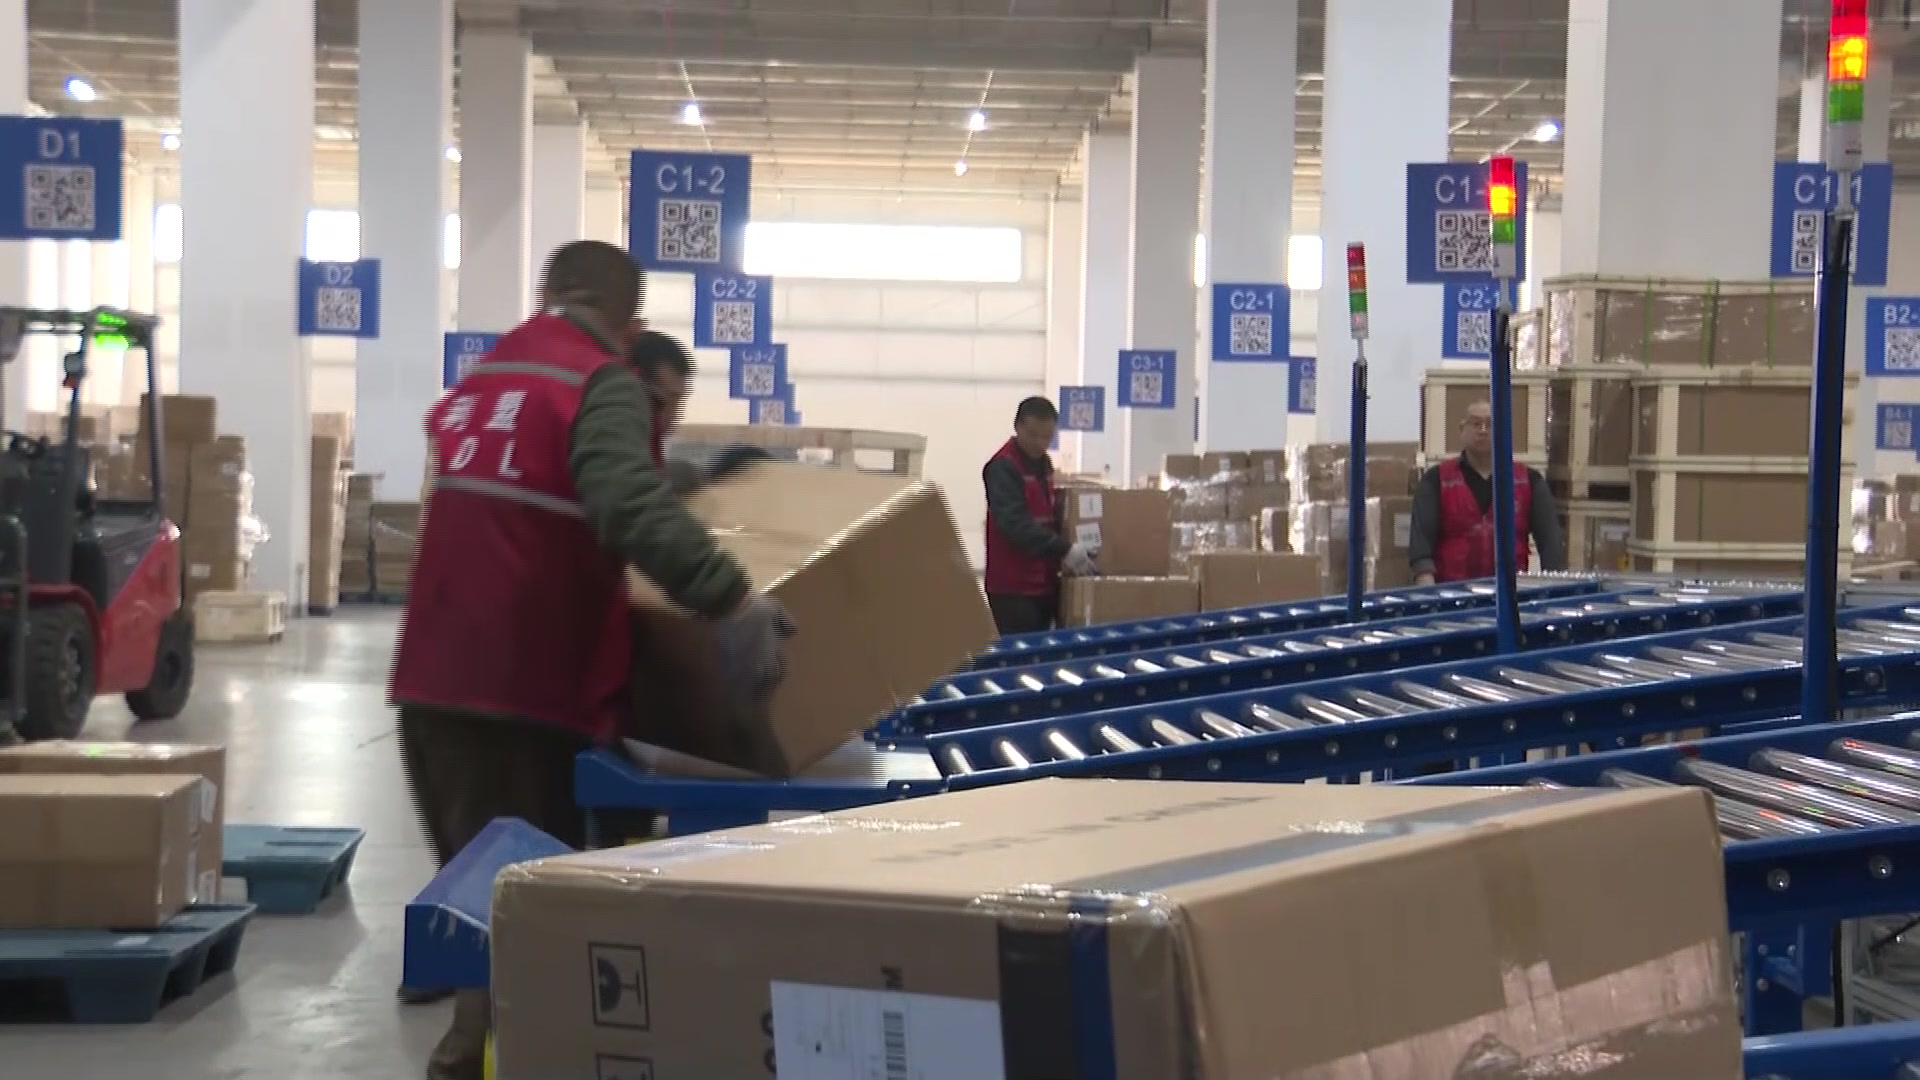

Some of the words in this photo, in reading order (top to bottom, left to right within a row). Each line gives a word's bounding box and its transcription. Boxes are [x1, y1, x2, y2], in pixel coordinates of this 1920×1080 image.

[39, 128, 81, 159] D1
[656, 163, 726, 195] C1-2
[1435, 174, 1486, 204] C1-
[1793, 174, 1862, 204] C11
[326, 265, 354, 285] D2
[712, 278, 758, 299] C2-2
[1229, 289, 1274, 311] C2-1
[1884, 304, 1920, 325] B2-
[1131, 355, 1164, 371] C3-1
